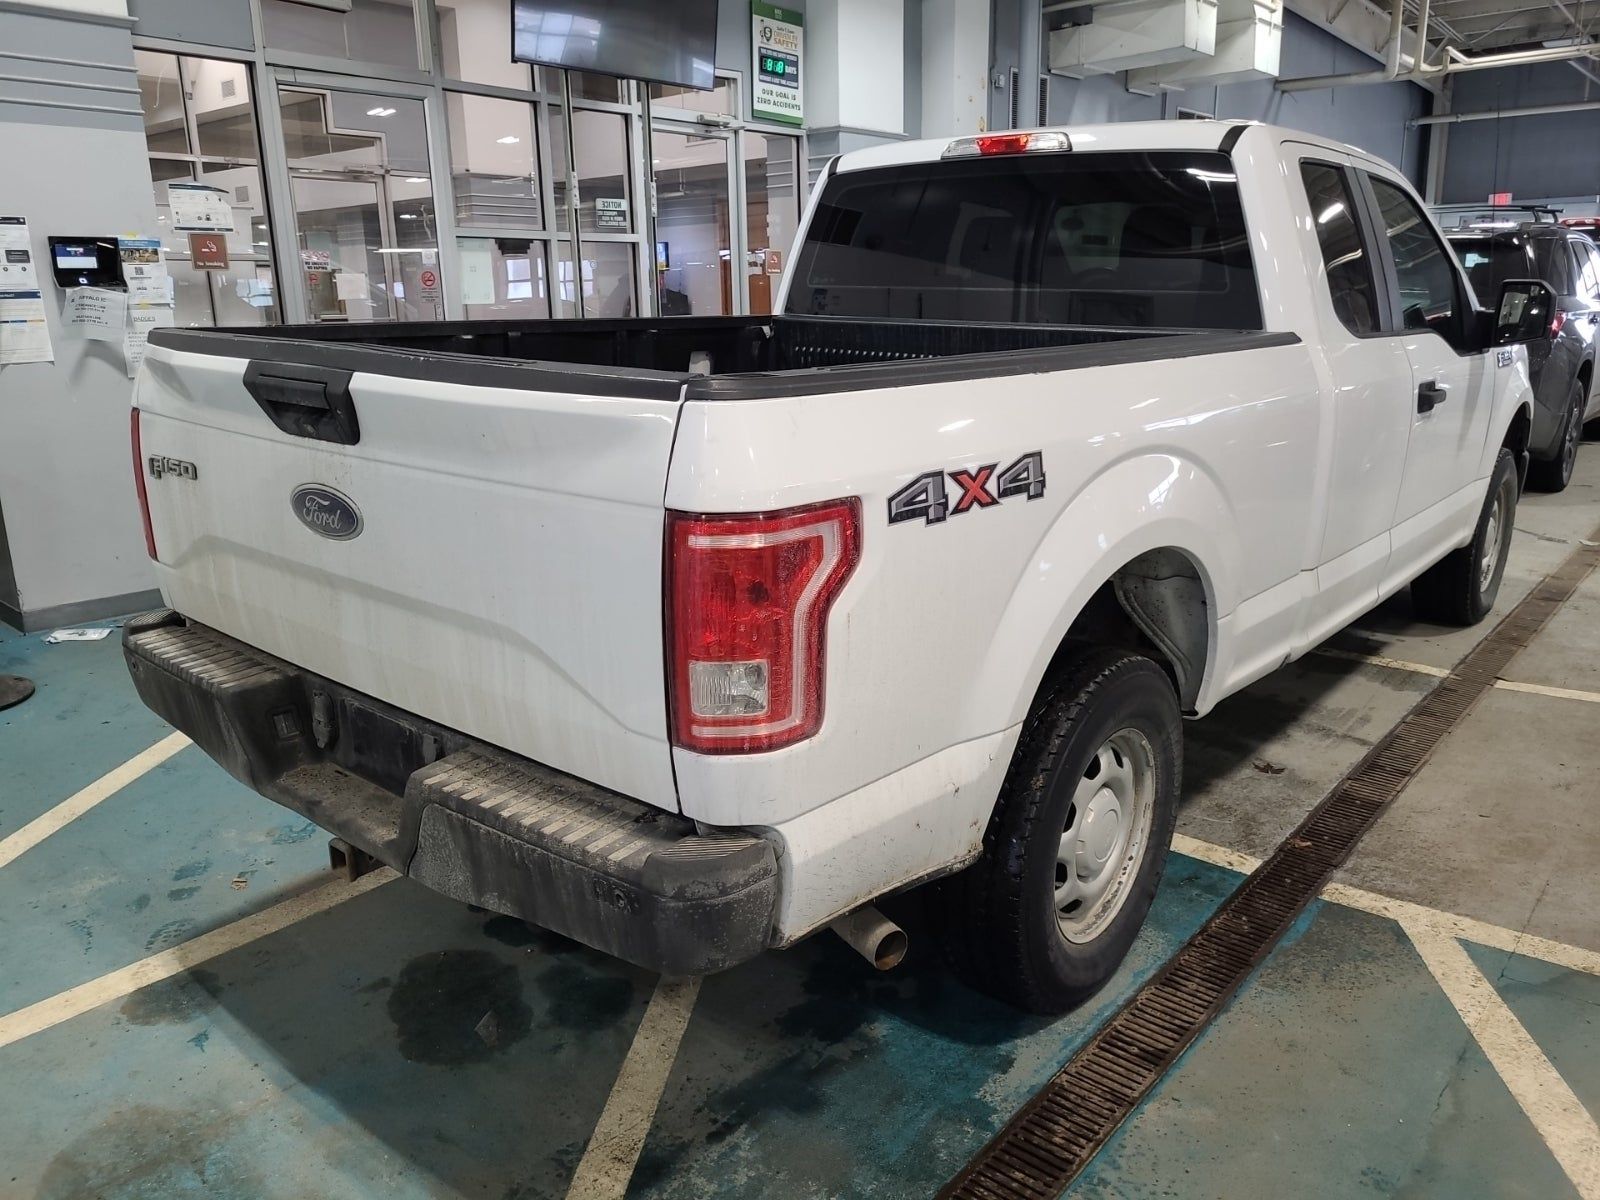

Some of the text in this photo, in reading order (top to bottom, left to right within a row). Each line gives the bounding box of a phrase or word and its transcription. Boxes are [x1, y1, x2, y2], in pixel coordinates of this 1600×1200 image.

[774, 38, 798, 49] SAFETY
[761, 88, 774, 96] OUR
[775, 91, 790, 99] GOAL
[757, 96, 801, 110] ZERO ACCIDENTS
[302, 494, 343, 530] Ford
